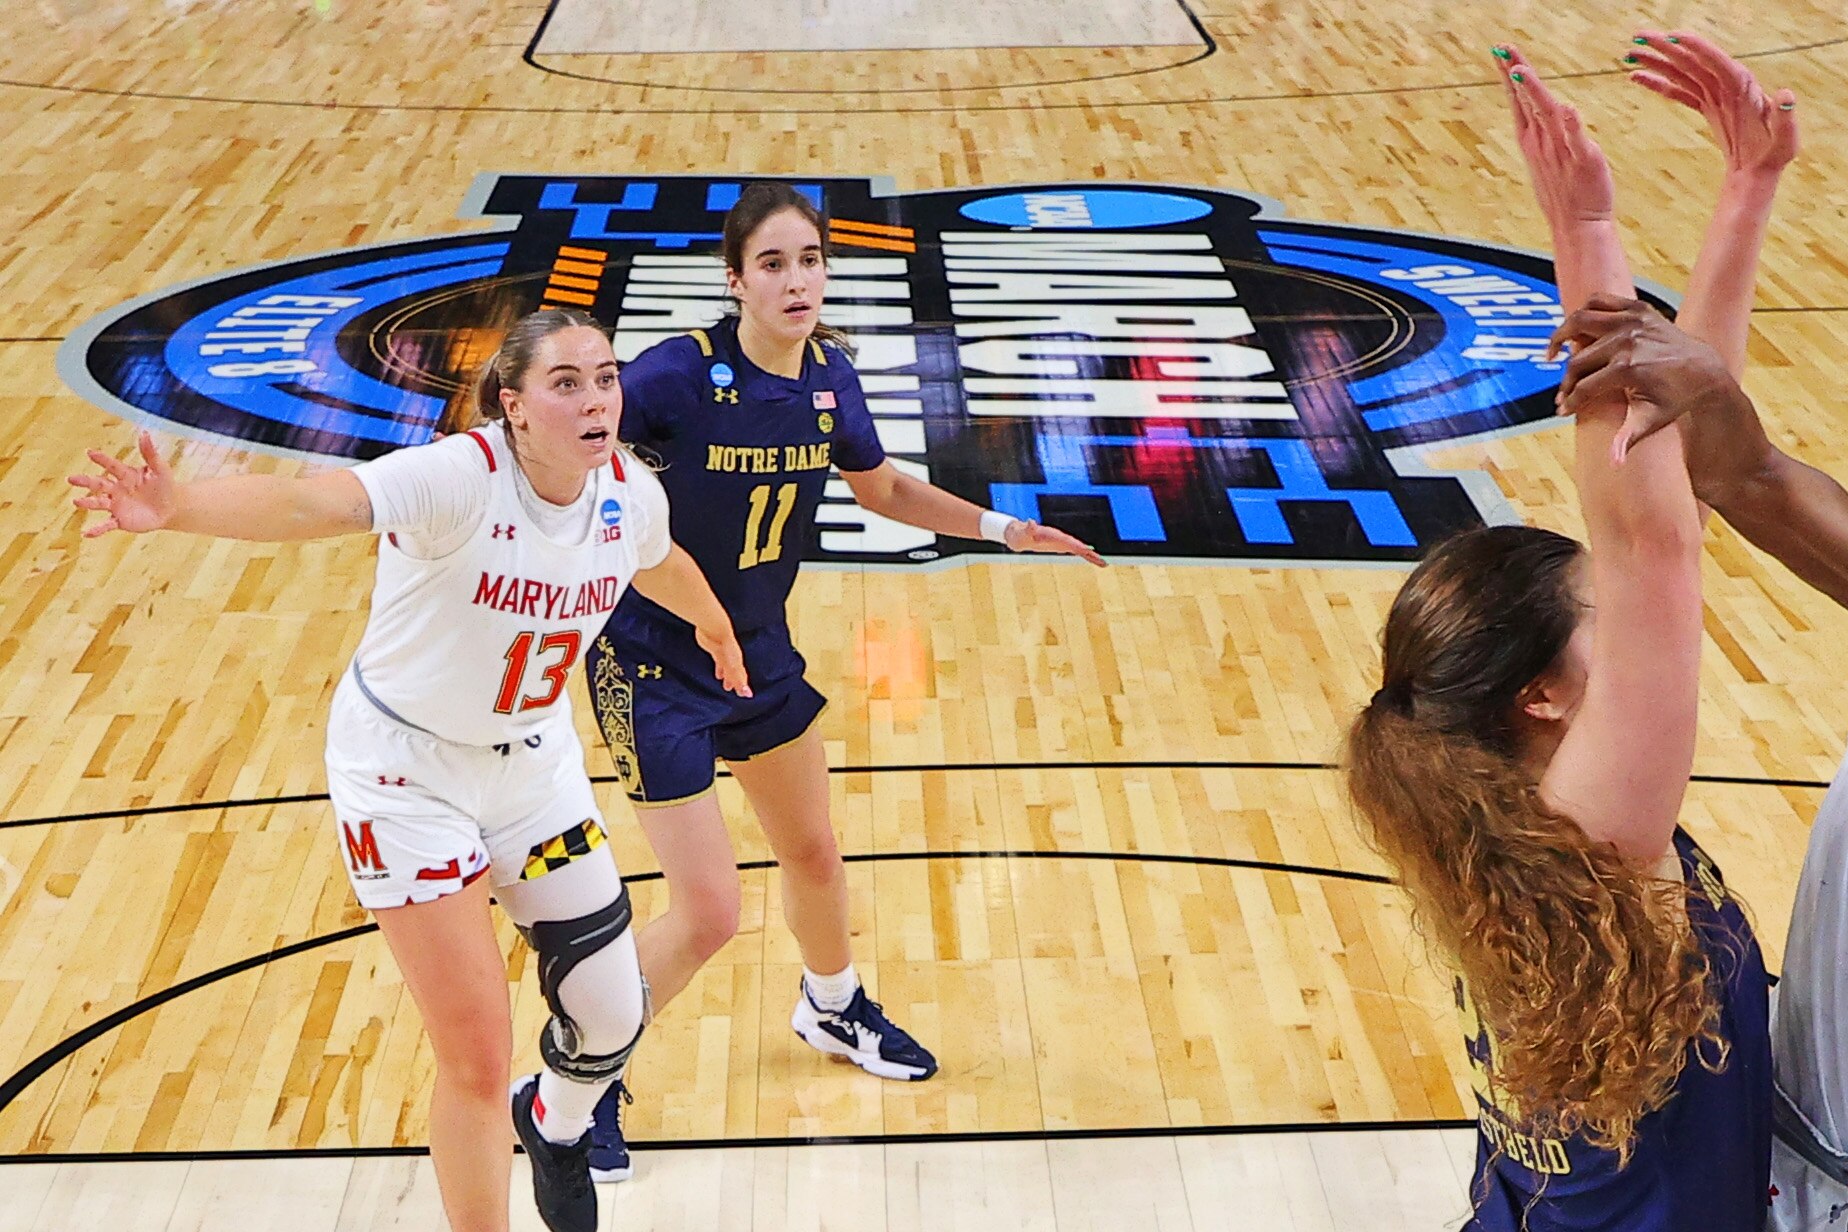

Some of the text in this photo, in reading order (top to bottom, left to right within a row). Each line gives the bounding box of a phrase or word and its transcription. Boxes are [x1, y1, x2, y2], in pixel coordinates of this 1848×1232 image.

[199, 294, 365, 378] ELITE 8
[939, 231, 1301, 420] MARCH
[1379, 264, 1566, 328] SWEET
[706, 443, 831, 473] NOTRE DAME
[738, 483, 798, 570] 11
[472, 571, 618, 620] MARYLAND
[493, 629, 582, 715] 13
